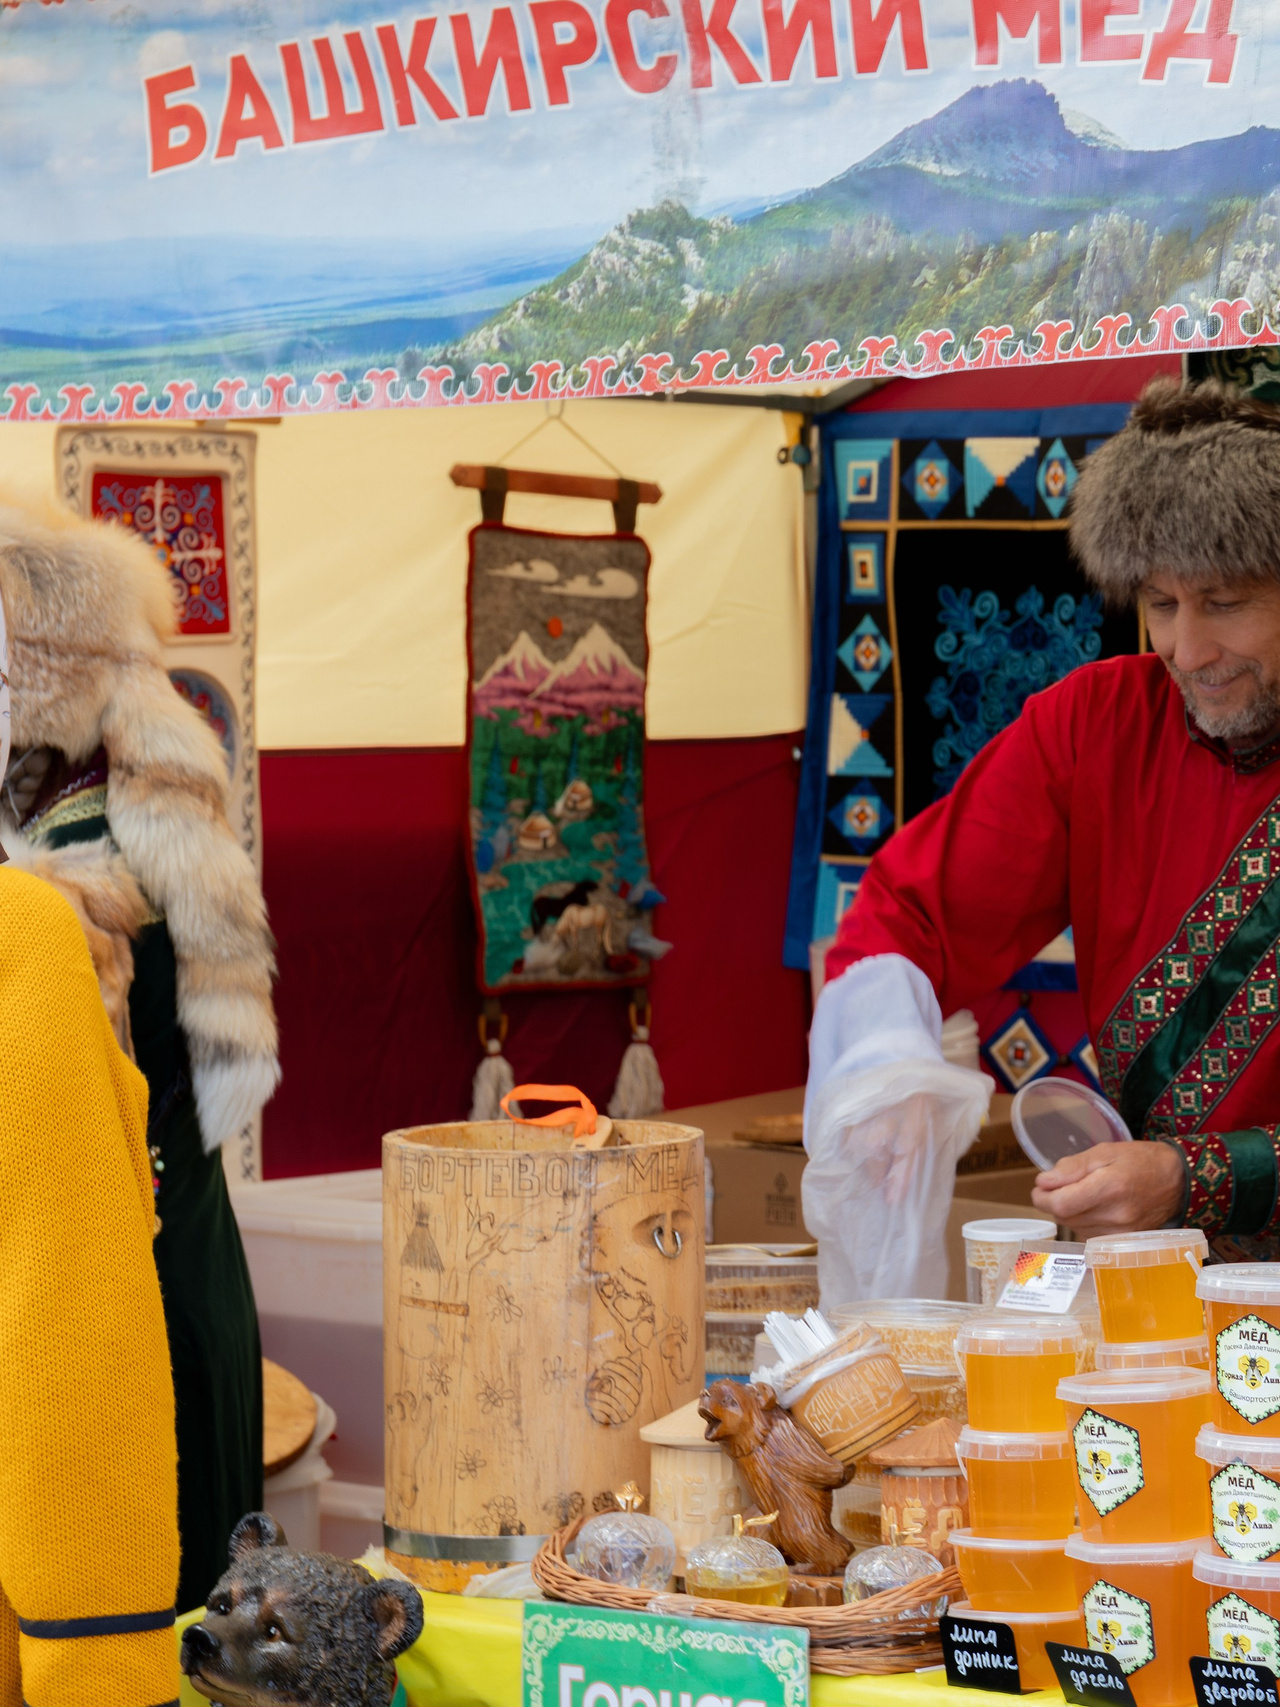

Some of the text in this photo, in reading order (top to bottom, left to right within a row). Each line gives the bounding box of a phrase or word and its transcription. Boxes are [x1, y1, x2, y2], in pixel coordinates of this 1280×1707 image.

[1238, 1328, 1269, 1344] МЁД
[1223, 1343, 1243, 1351] Пасека
[1221, 1369, 1244, 1381] Горная
[1084, 1423, 1107, 1438] МЁД
[1228, 1474, 1255, 1490] МЁД
[1232, 1489, 1276, 1502] Давлетшиных
[1222, 1535, 1272, 1549] Башкортостан
[1222, 1607, 1249, 1623] МЁД
[949, 1623, 999, 1648] липа
[953, 1648, 1019, 1677] донник
[1060, 1648, 1109, 1671] липа
[1201, 1661, 1260, 1683] липа
[1069, 1668, 1126, 1694] дягель
[1202, 1681, 1278, 1707] зверобой
